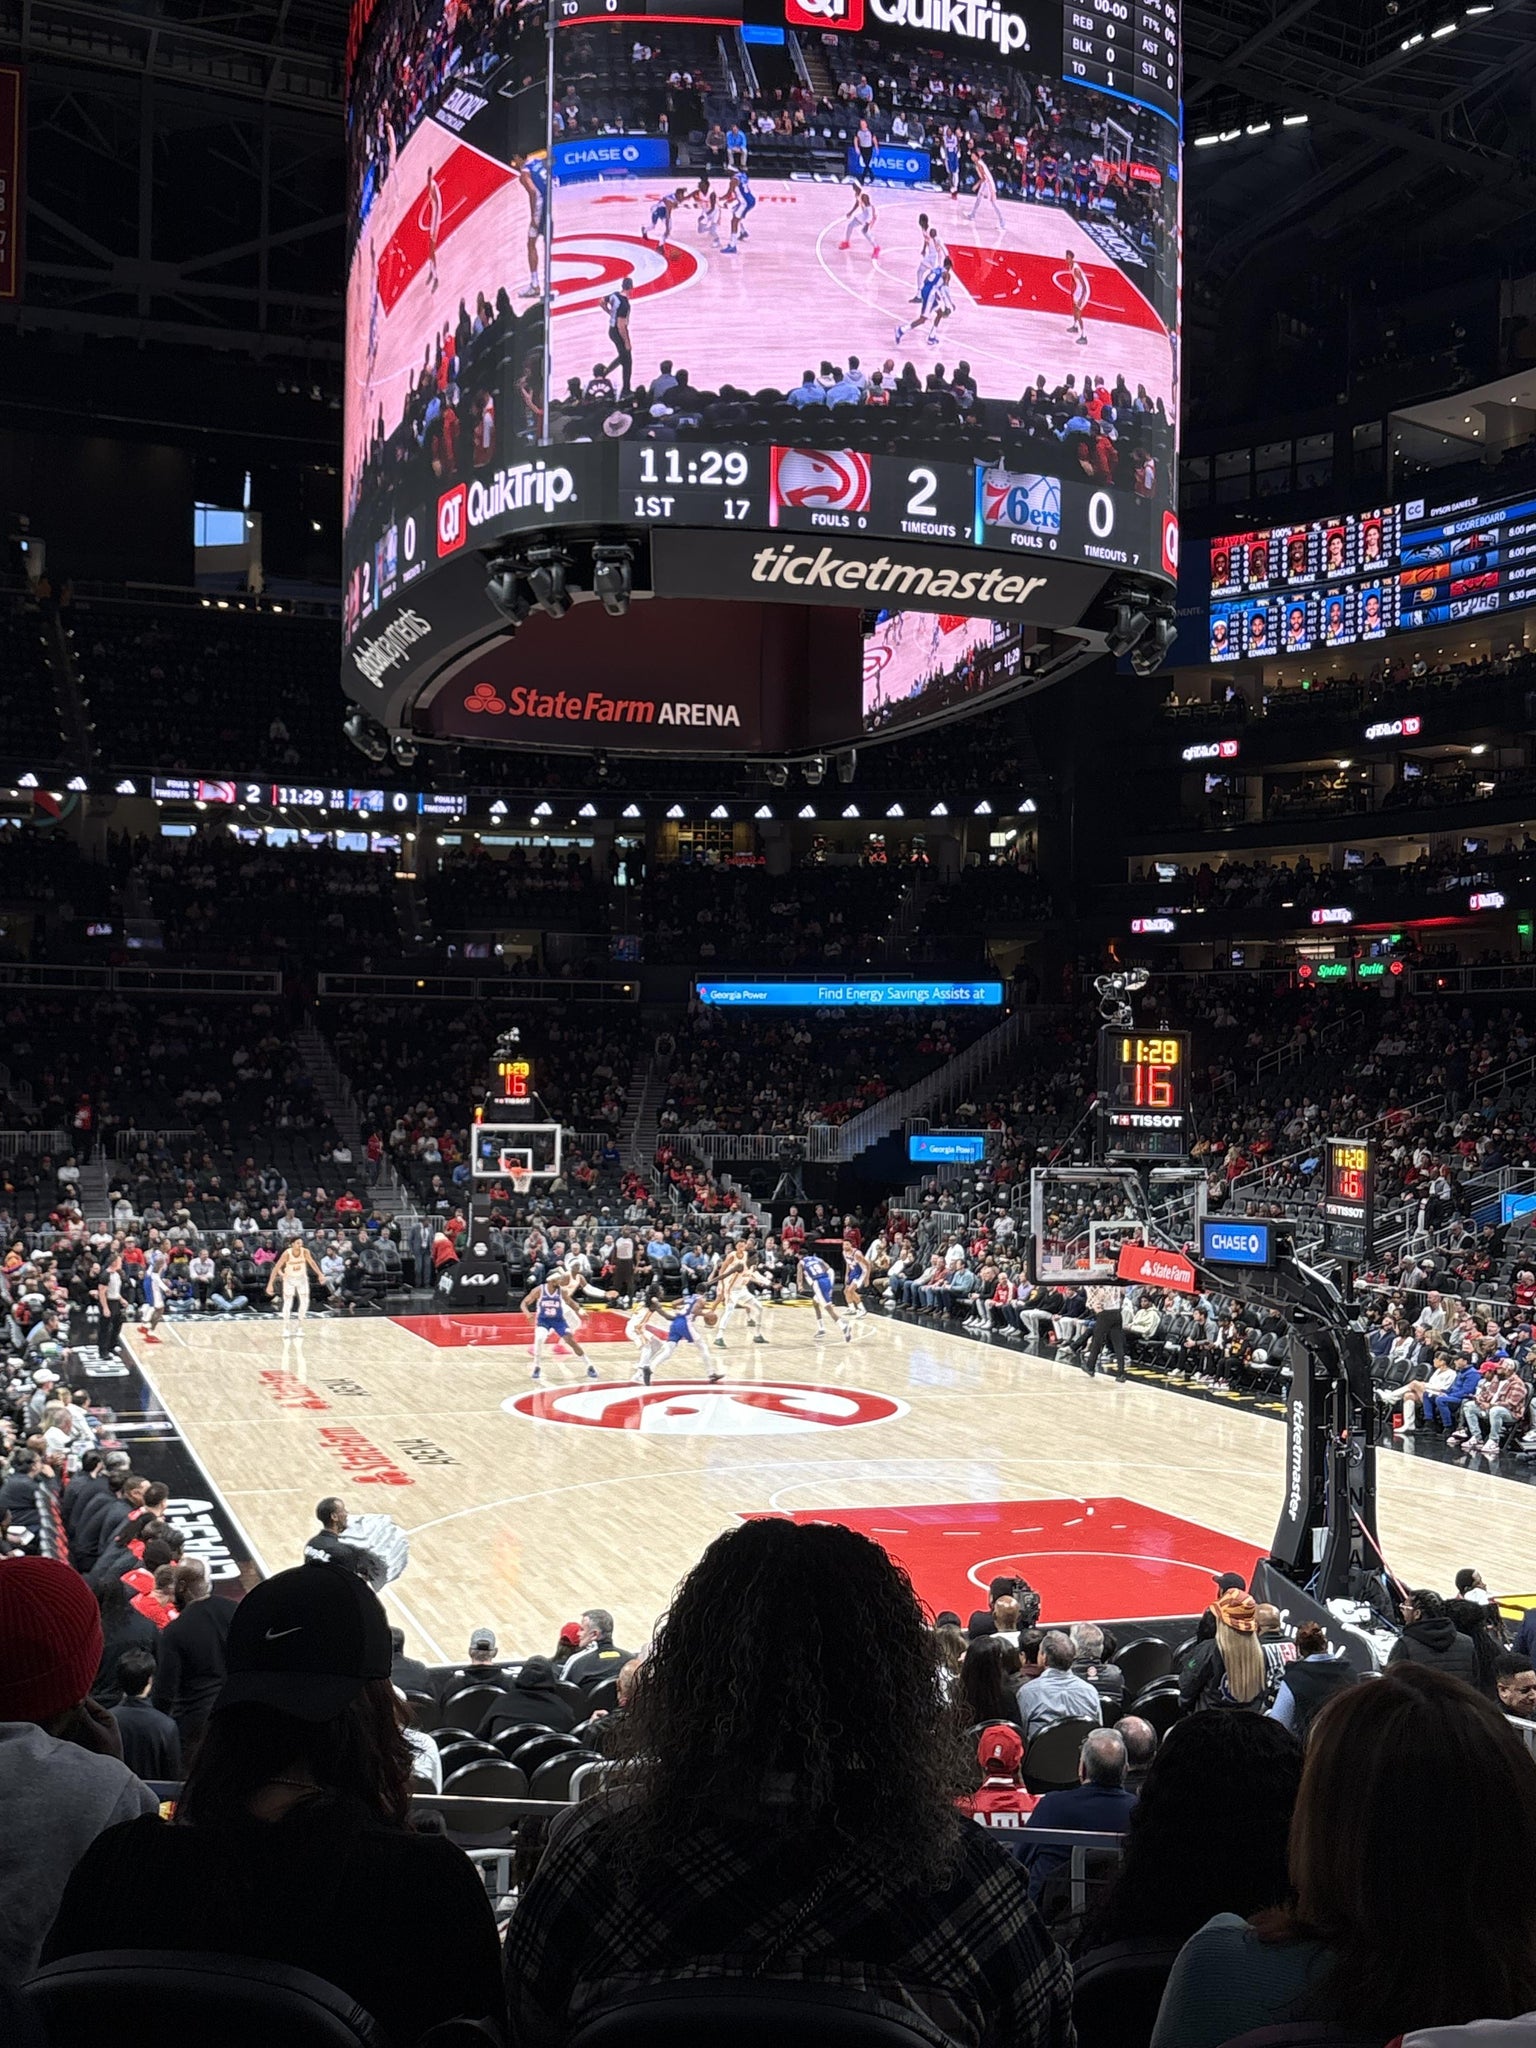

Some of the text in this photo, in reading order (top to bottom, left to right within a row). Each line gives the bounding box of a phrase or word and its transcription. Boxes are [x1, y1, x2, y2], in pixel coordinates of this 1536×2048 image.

[562, 0, 617, 15] TO 0
[1165, 4, 1176, 23] 0%
[1072, 13, 1176, 46] REB 0 FT% 0%
[1072, 37, 1174, 67] BLK 0 AST 0
[1072, 61, 1173, 90] TO 1 STL 0
[563, 147, 621, 165] CHASE
[639, 448, 749, 486] 11:29
[634, 496, 750, 520] 1ST 17
[907, 468, 938, 517] 2
[1088, 491, 1115, 538] 0
[1407, 504, 1422, 516] CC
[440, 494, 463, 543] QT
[811, 513, 867, 529] FOULS 0
[1271, 527, 1292, 539] 100%
[1373, 509, 1380, 519] 0
[1394, 504, 1401, 514] 7
[1455, 511, 1506, 533] SCOREBOARD
[901, 520, 972, 539] TIMEOUTS 7
[1011, 533, 1057, 551] FOULS 0
[363, 517, 416, 603] 2 0
[1084, 544, 1139, 565] TIMEOUTS 7
[751, 543, 1047, 605] ticketmaster
[1363, 559, 1389, 571] DANIELS
[1248, 581, 1269, 591] GUEYE
[1287, 573, 1316, 585] WALLACE
[1373, 579, 1380, 589] 0
[1394, 575, 1400, 585] 7
[1286, 641, 1311, 653] BUTLER
[1326, 636, 1349, 647] WALKER
[1003, 647, 1020, 668] 11:29
[1248, 647, 1277, 657] EDWARDS
[658, 702, 740, 727] ARENA
[155, 789, 190, 799] TIMEOUTS
[246, 785, 261, 803] 2
[279, 787, 324, 806] 11:29
[330, 790, 345, 800] 16
[393, 793, 408, 812] 0
[423, 805, 455, 814] TIMEOUTS
[1317, 964, 1347, 978] Sprite
[1359, 963, 1384, 977] Sprite
[710, 990, 767, 1000] Georgia Power
[818, 987, 986, 1001] Find Energy Savings Assists at
[1122, 1039, 1178, 1064] 11:28
[506, 1075, 526, 1096] 16
[1135, 1064, 1173, 1107] 16
[1130, 1114, 1183, 1127] TISSOT
[1335, 1148, 1366, 1170] 11:28
[1343, 1170, 1360, 1198] 16
[1337, 1205, 1365, 1219] TISSOT
[1211, 1235, 1247, 1251] CHASE
[393, 1437, 462, 1465] ARENA
[1288, 1400, 1304, 1522] ticketmaster
